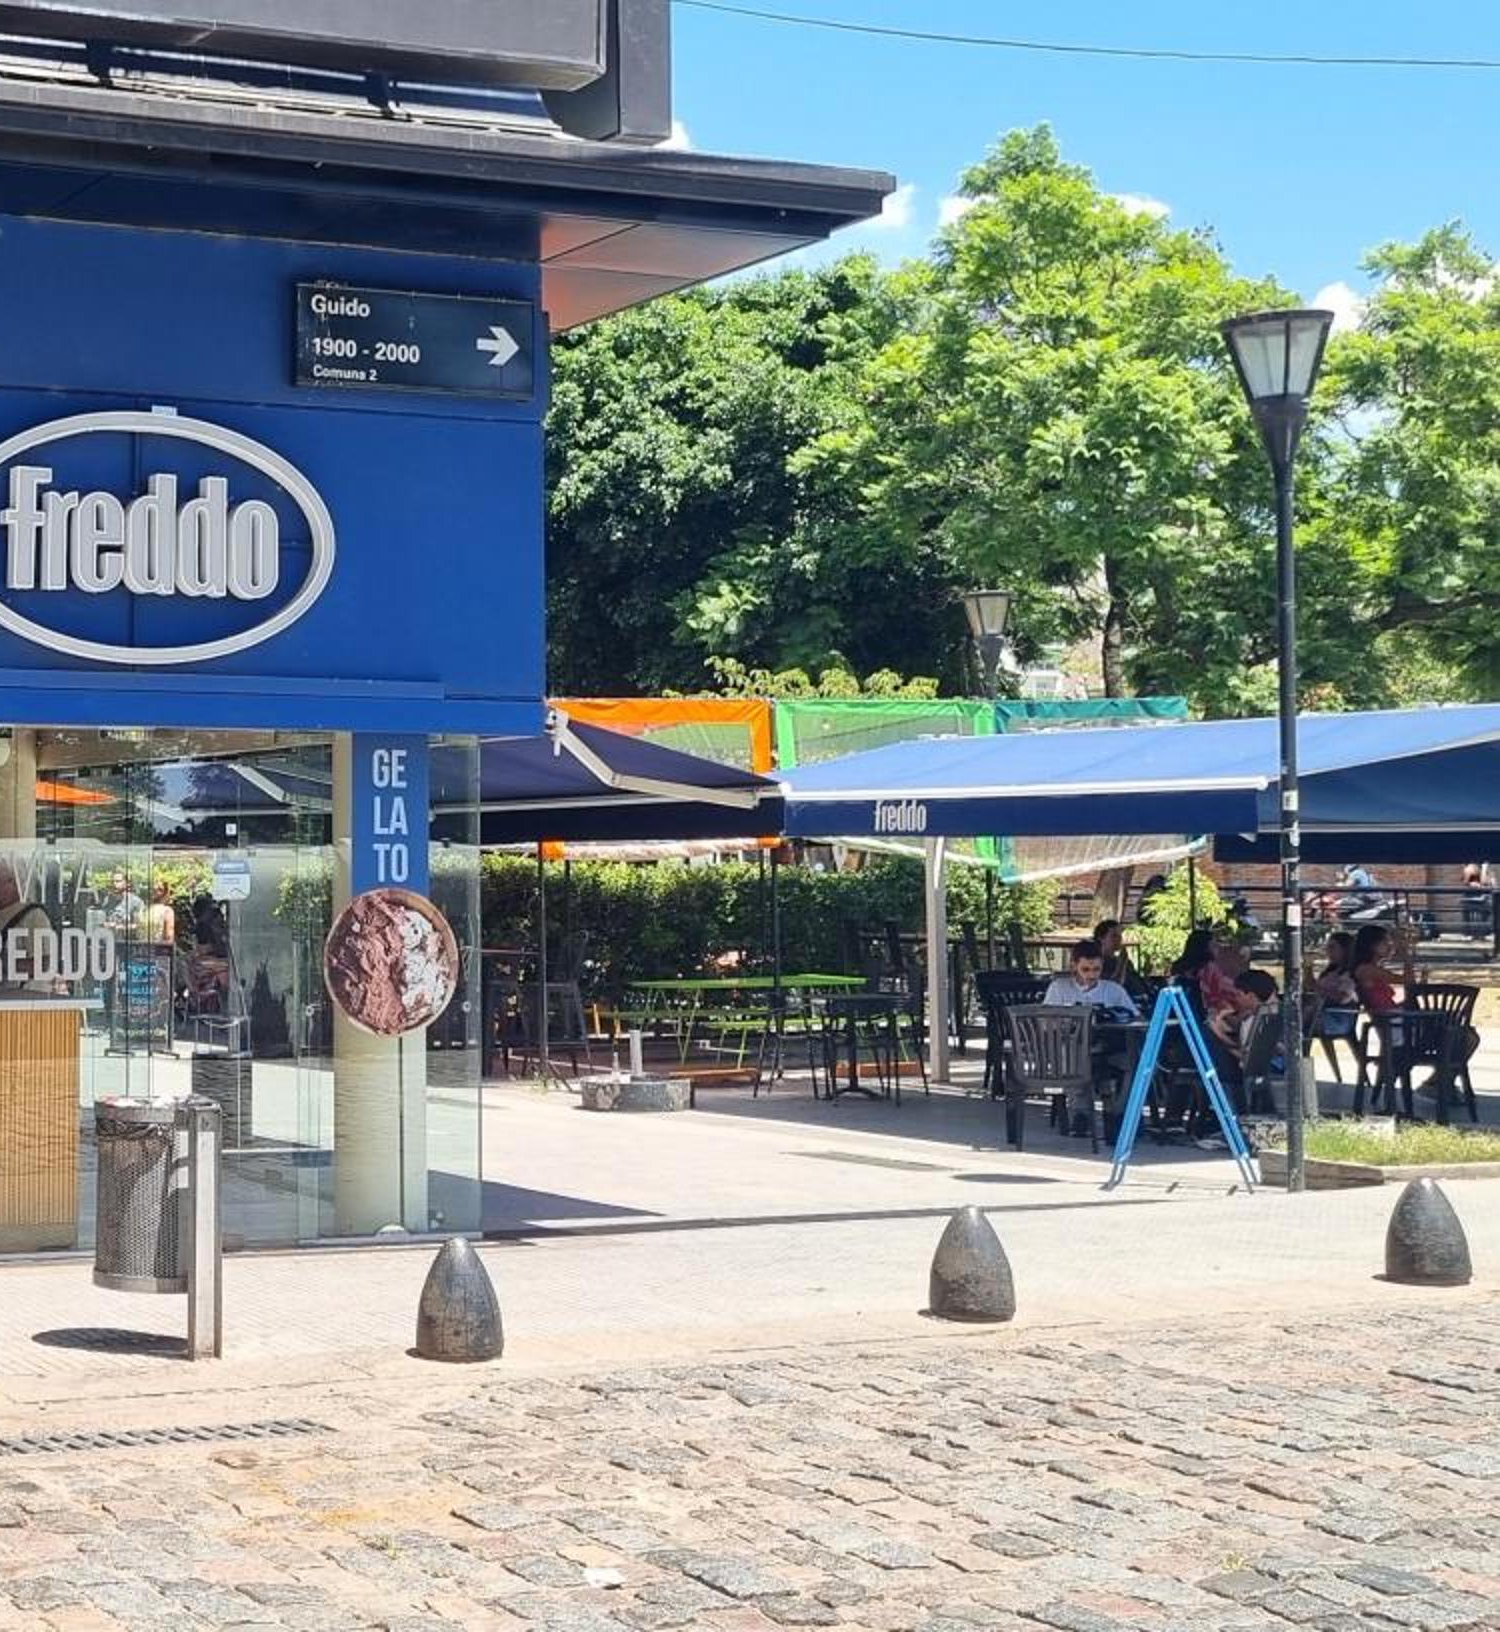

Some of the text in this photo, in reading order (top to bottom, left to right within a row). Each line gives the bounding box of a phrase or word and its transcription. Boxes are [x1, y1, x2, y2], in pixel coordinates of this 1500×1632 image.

[311, 294, 371, 318] Guido
[312, 337, 358, 358] 1900
[375, 343, 421, 363] 2000
[313, 364, 378, 381] Comuna 2
[0, 465, 280, 601] freddo
[372, 749, 408, 789] GE
[373, 796, 409, 835] LA
[873, 799, 928, 832] freddo
[372, 842, 409, 883] TO
